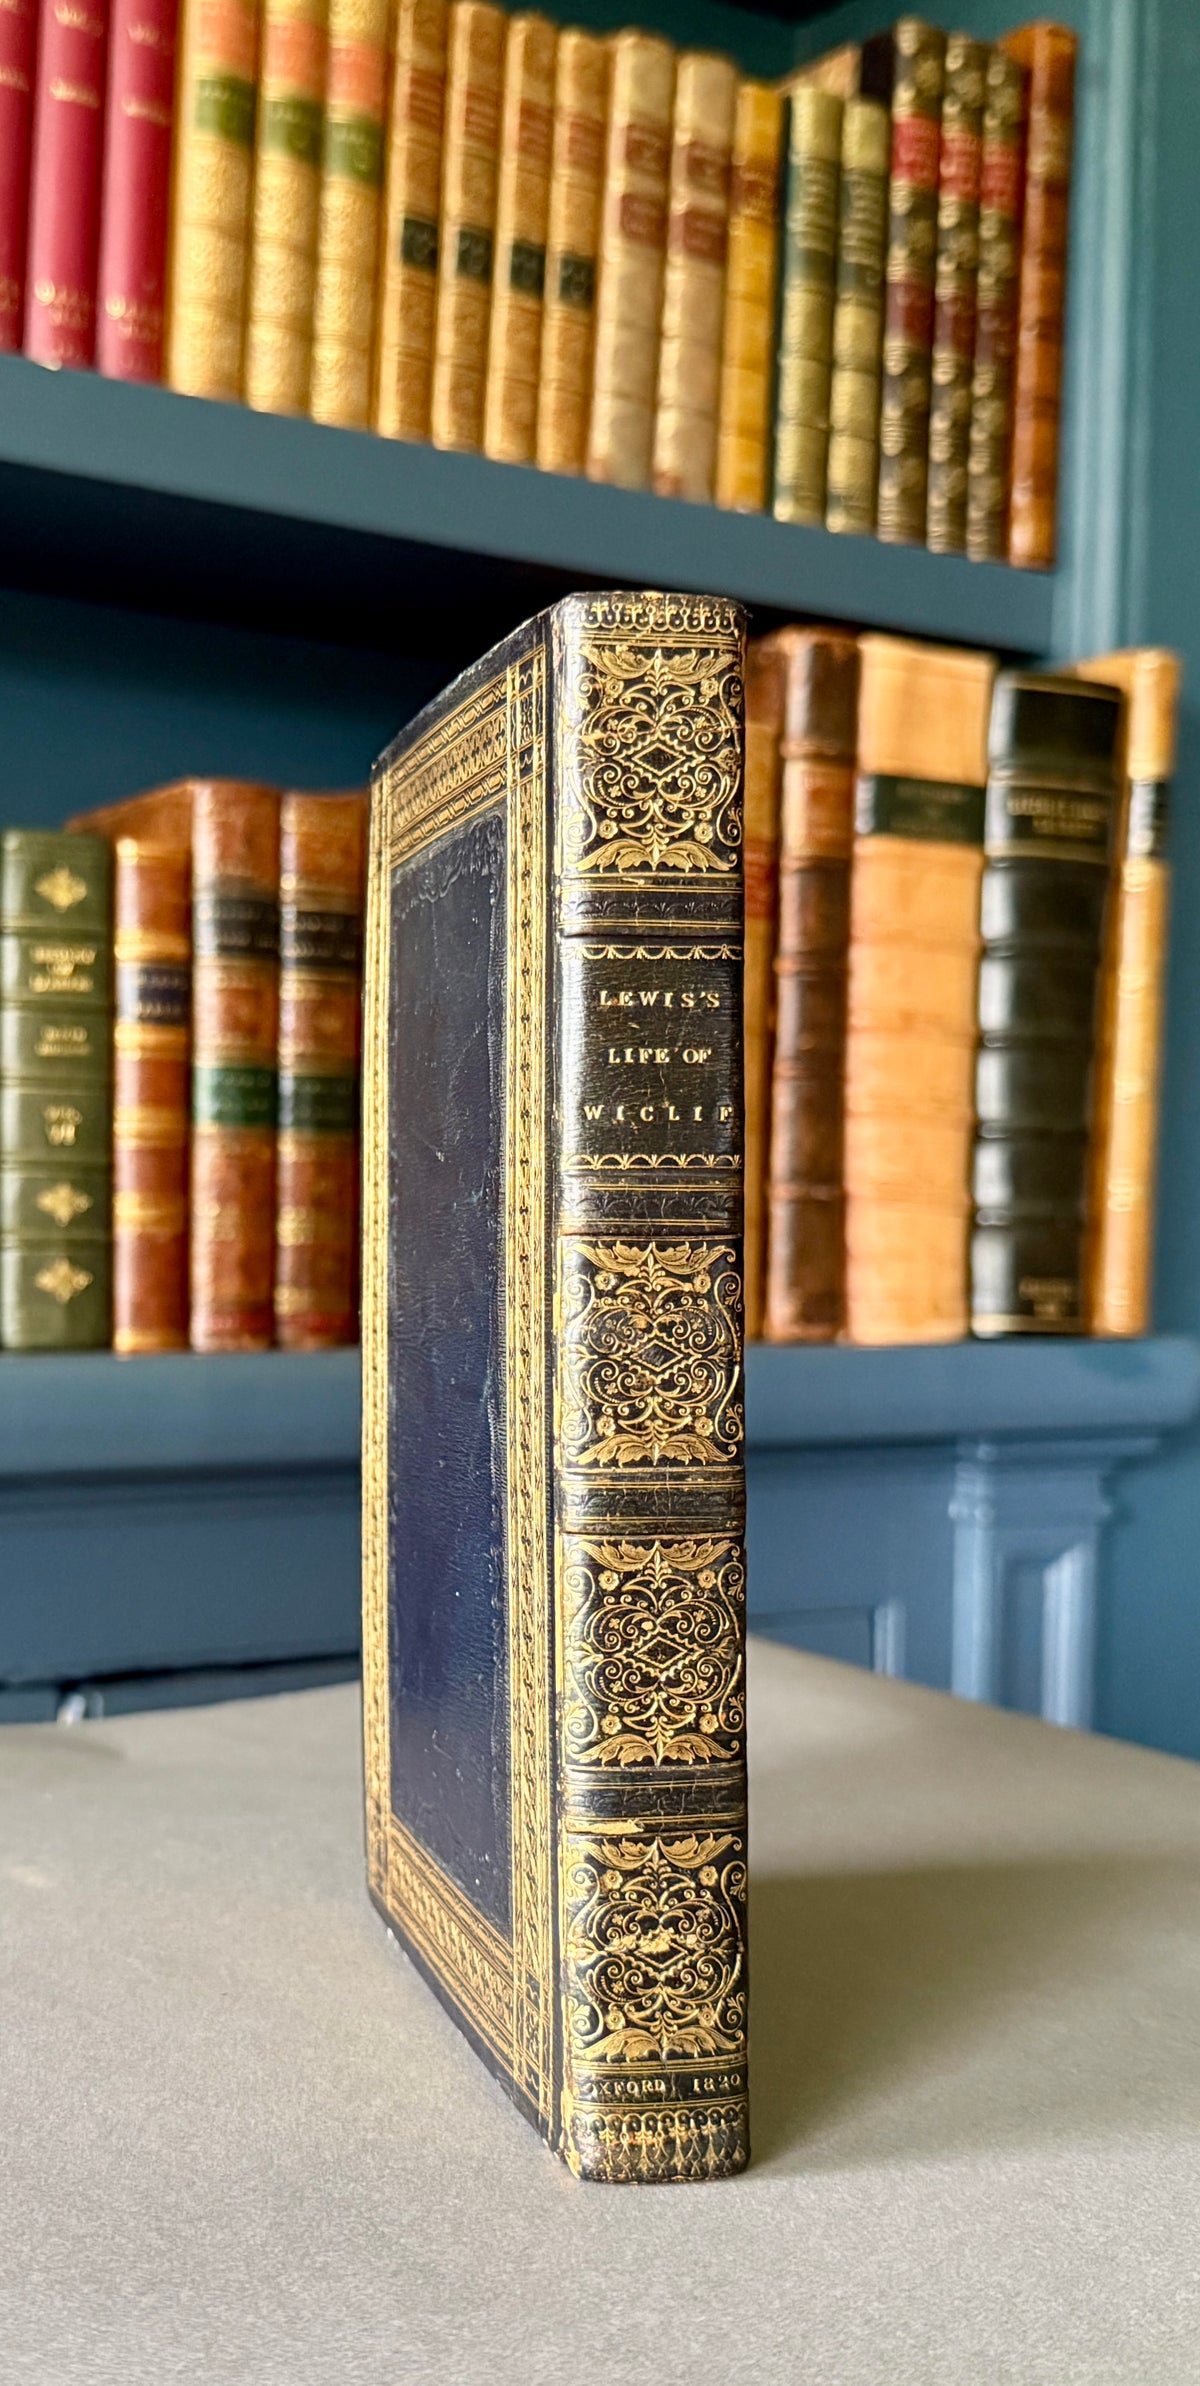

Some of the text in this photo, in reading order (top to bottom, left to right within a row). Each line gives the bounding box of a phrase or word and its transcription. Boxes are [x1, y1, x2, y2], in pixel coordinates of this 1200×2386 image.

[600, 990, 720, 1007] LEWIS'S
[608, 1048, 712, 1064] LIFE OF
[584, 1105, 733, 1123] WICLIF
[693, 2073, 740, 2094] 1820
